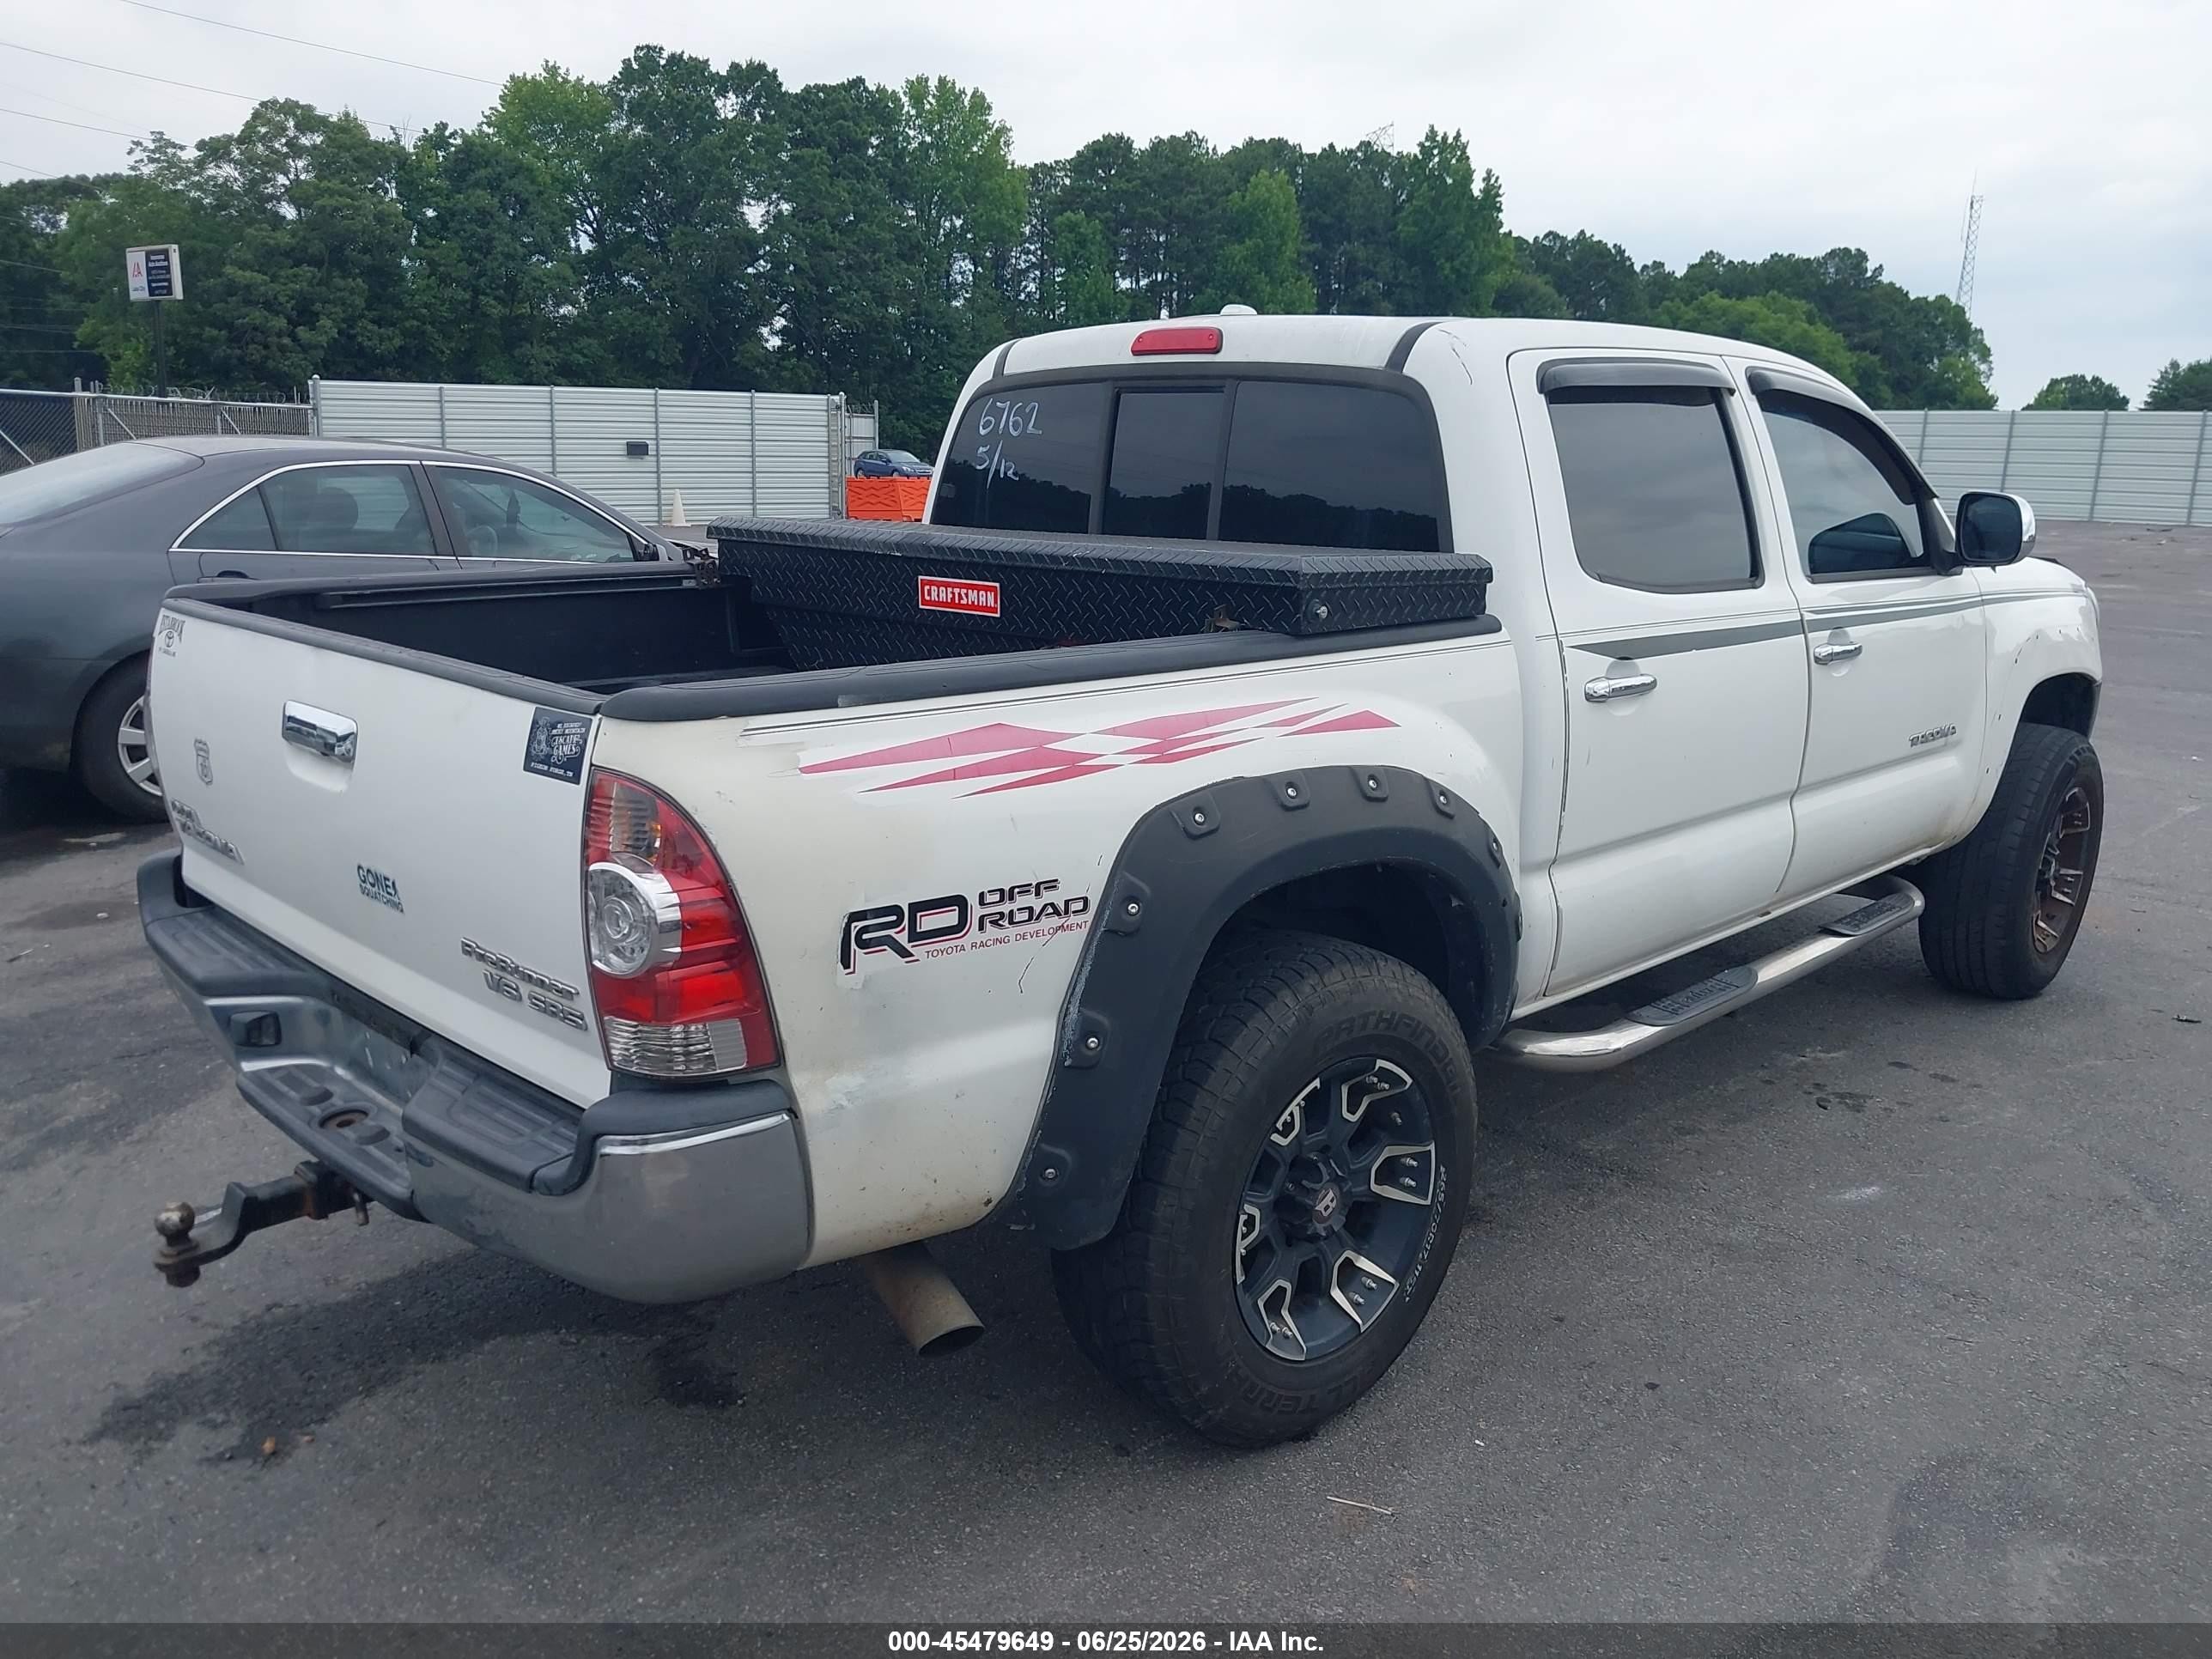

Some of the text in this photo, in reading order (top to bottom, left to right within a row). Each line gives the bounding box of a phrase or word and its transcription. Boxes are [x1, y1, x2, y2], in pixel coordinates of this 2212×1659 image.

[979, 398, 1042, 437] 6762
[975, 440, 1019, 489] 5/12
[924, 586, 994, 607] CRAFTSMAN
[357, 865, 393, 896] GONE
[979, 878, 1060, 908] OFF
[978, 896, 1091, 933] ROAD
[925, 920, 1090, 959] TOYOTA RACING DEVELOPMENT
[460, 937, 580, 1000] PreRunner
[483, 969, 588, 1030] V6 SR5
